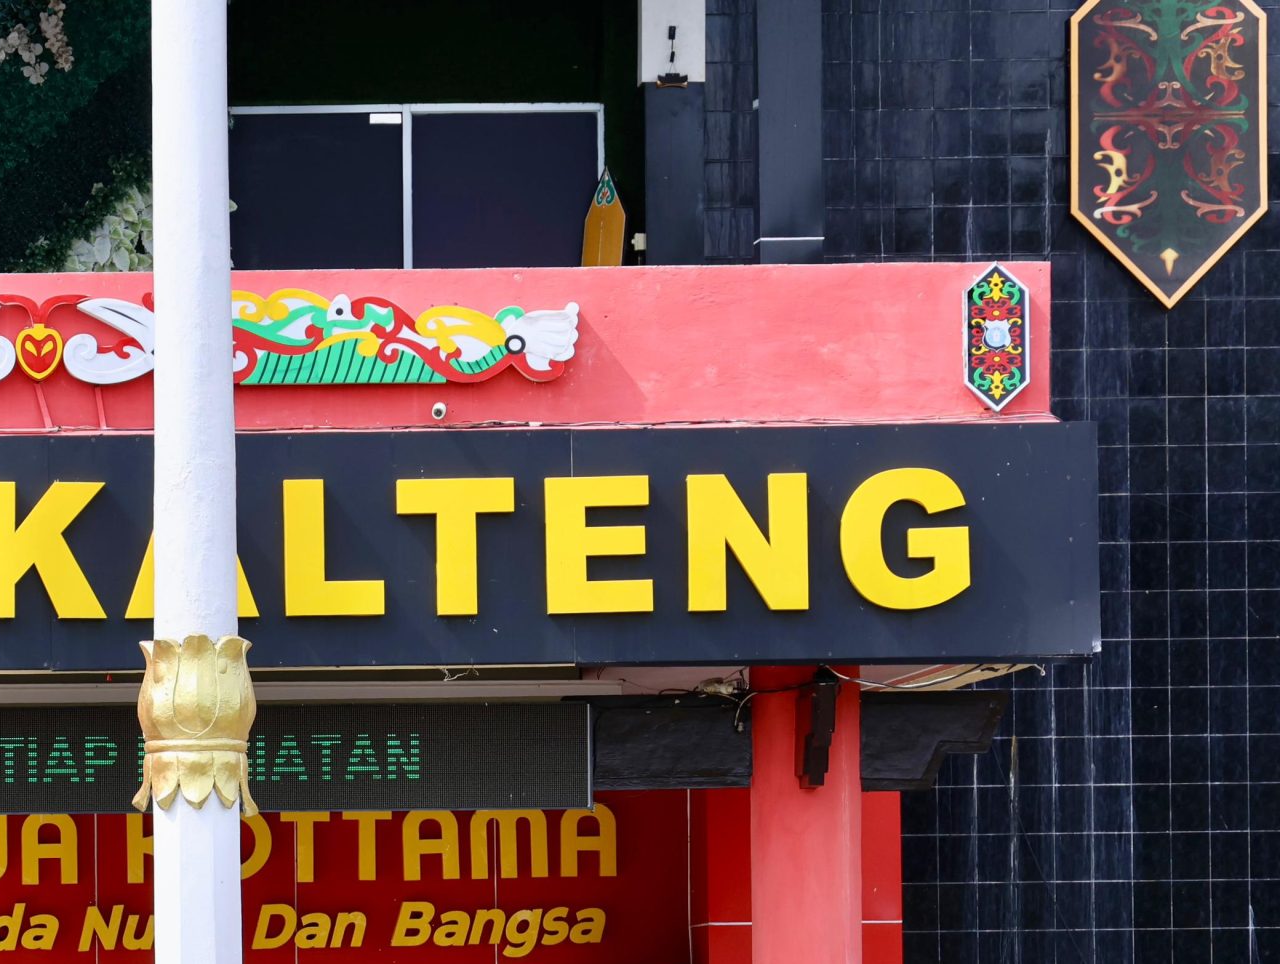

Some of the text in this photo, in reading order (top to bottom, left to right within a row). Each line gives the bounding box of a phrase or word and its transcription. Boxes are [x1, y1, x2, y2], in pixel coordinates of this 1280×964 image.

[137, 733, 421, 782] IATAN
[78, 903, 156, 952] Nu
[251, 903, 367, 950] Dan
[390, 901, 607, 958] Bangsa
